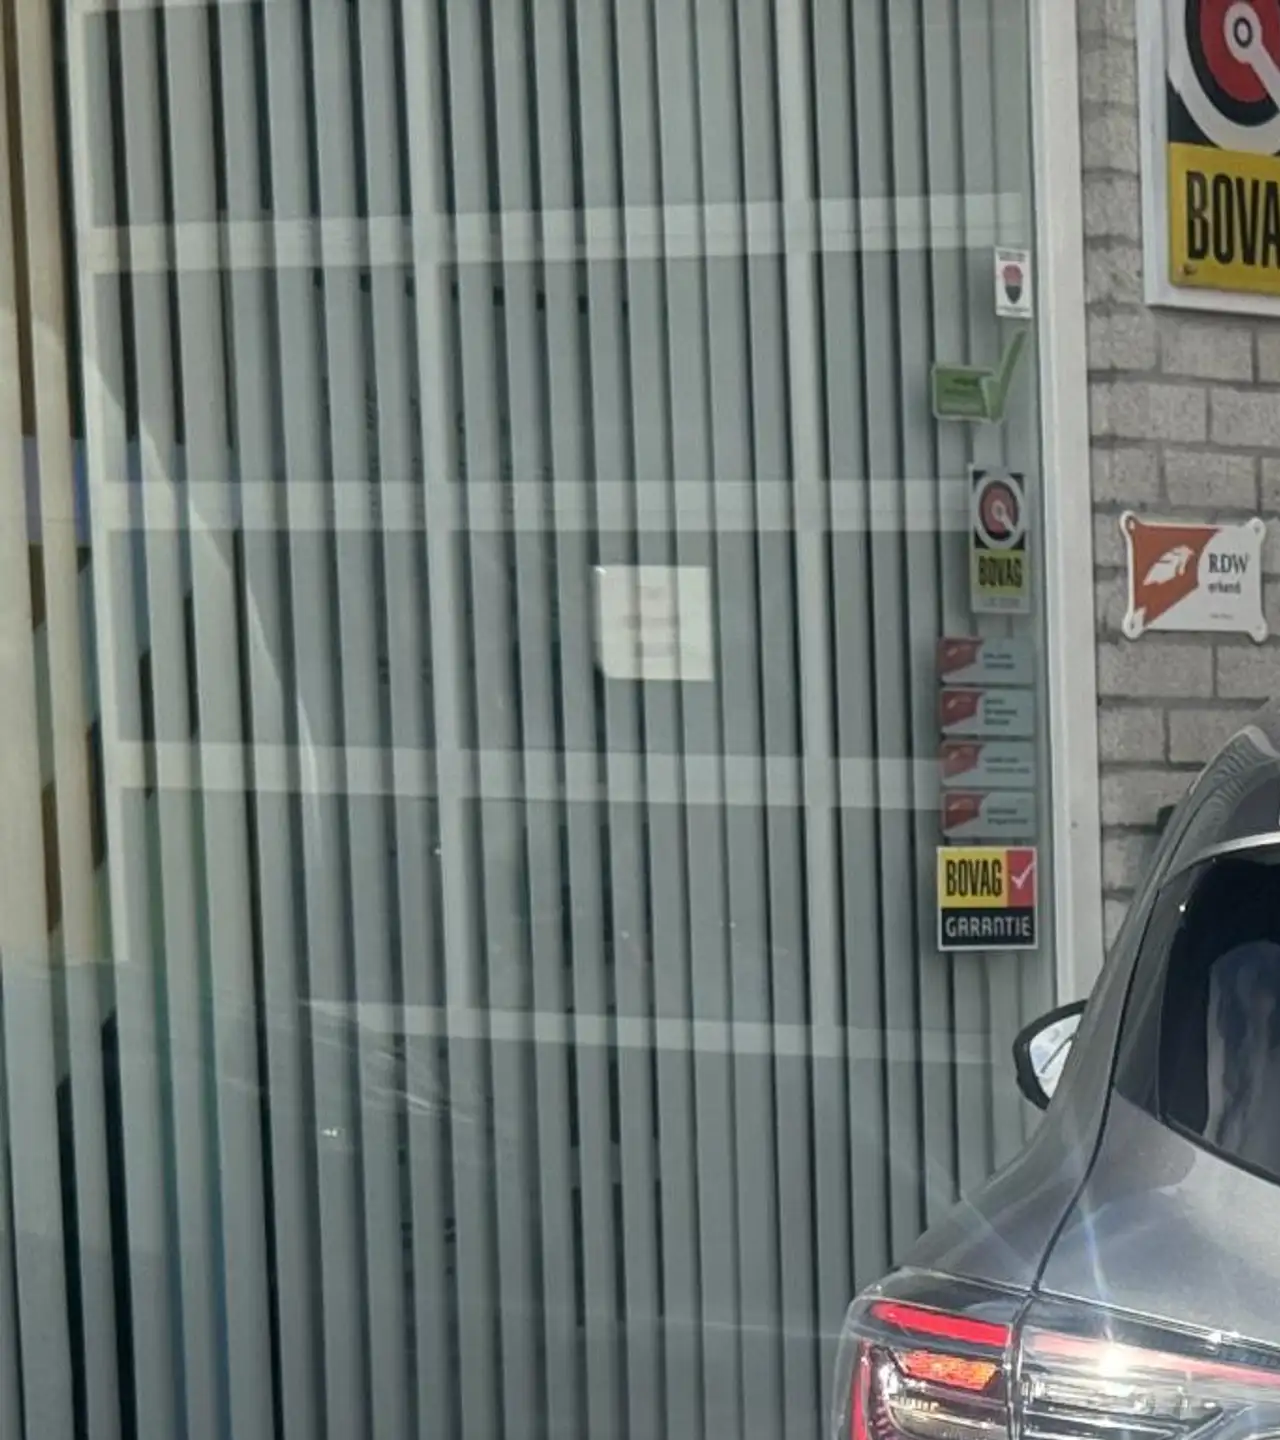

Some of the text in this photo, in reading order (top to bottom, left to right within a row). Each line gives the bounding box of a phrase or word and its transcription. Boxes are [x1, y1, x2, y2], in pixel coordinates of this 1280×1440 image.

[1208, 552, 1248, 573] RDW
[946, 858, 1003, 897] BOVAG
[945, 915, 1032, 937] GARANTIE
